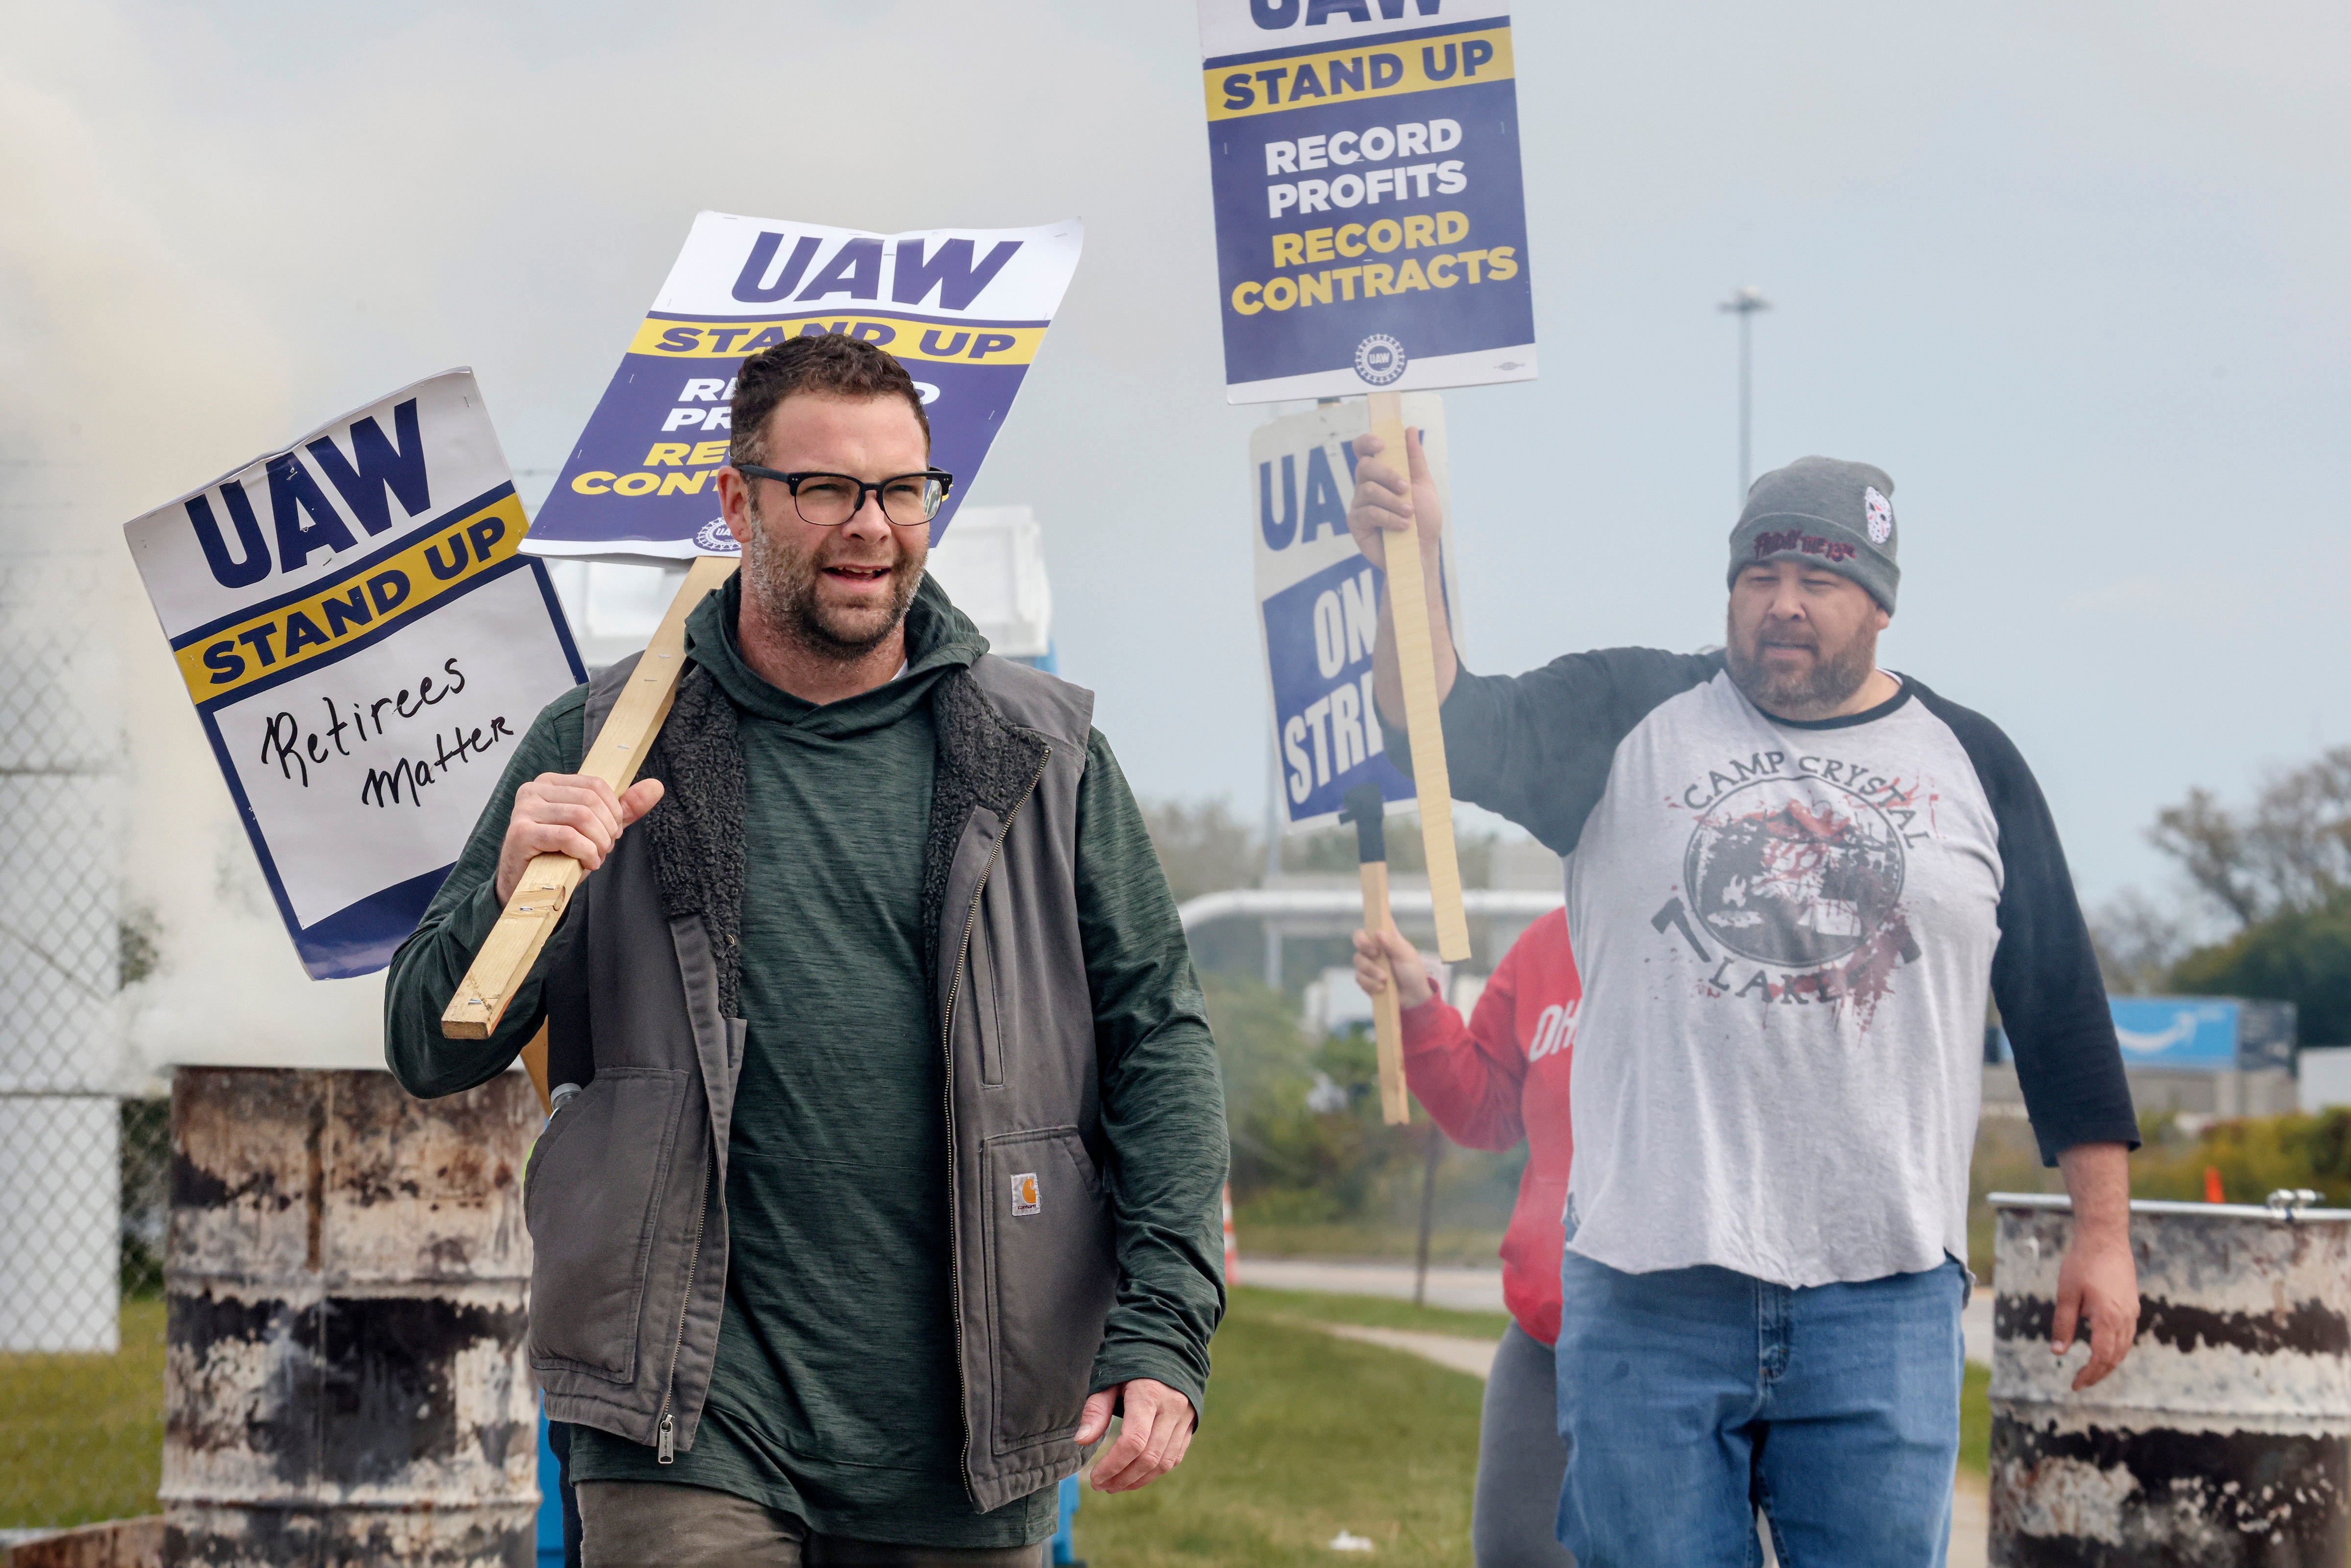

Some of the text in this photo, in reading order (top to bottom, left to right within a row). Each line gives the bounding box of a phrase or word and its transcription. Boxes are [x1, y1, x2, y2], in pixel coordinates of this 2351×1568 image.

[1223, 40, 1493, 110] STAND UP
[1265, 119, 1463, 176] RECORD
[1268, 160, 1467, 218] PROFITS
[731, 231, 1024, 311] UAW
[1272, 211, 1469, 268] RECORD
[1232, 246, 1518, 315] CONTRACTS
[919, 330, 1016, 358] UP
[1369, 353, 1390, 364] UAW
[185, 397, 431, 588] UAW
[203, 516, 506, 685] STAND UP
[1314, 567, 1377, 679] ON
[262, 658, 465, 787] Retirees
[1284, 670, 1384, 805] STRI
[1684, 751, 1929, 849] CAMP CRYSTAL
[1709, 956, 1844, 1004] LAKE
[1528, 998, 1583, 1063] OH
